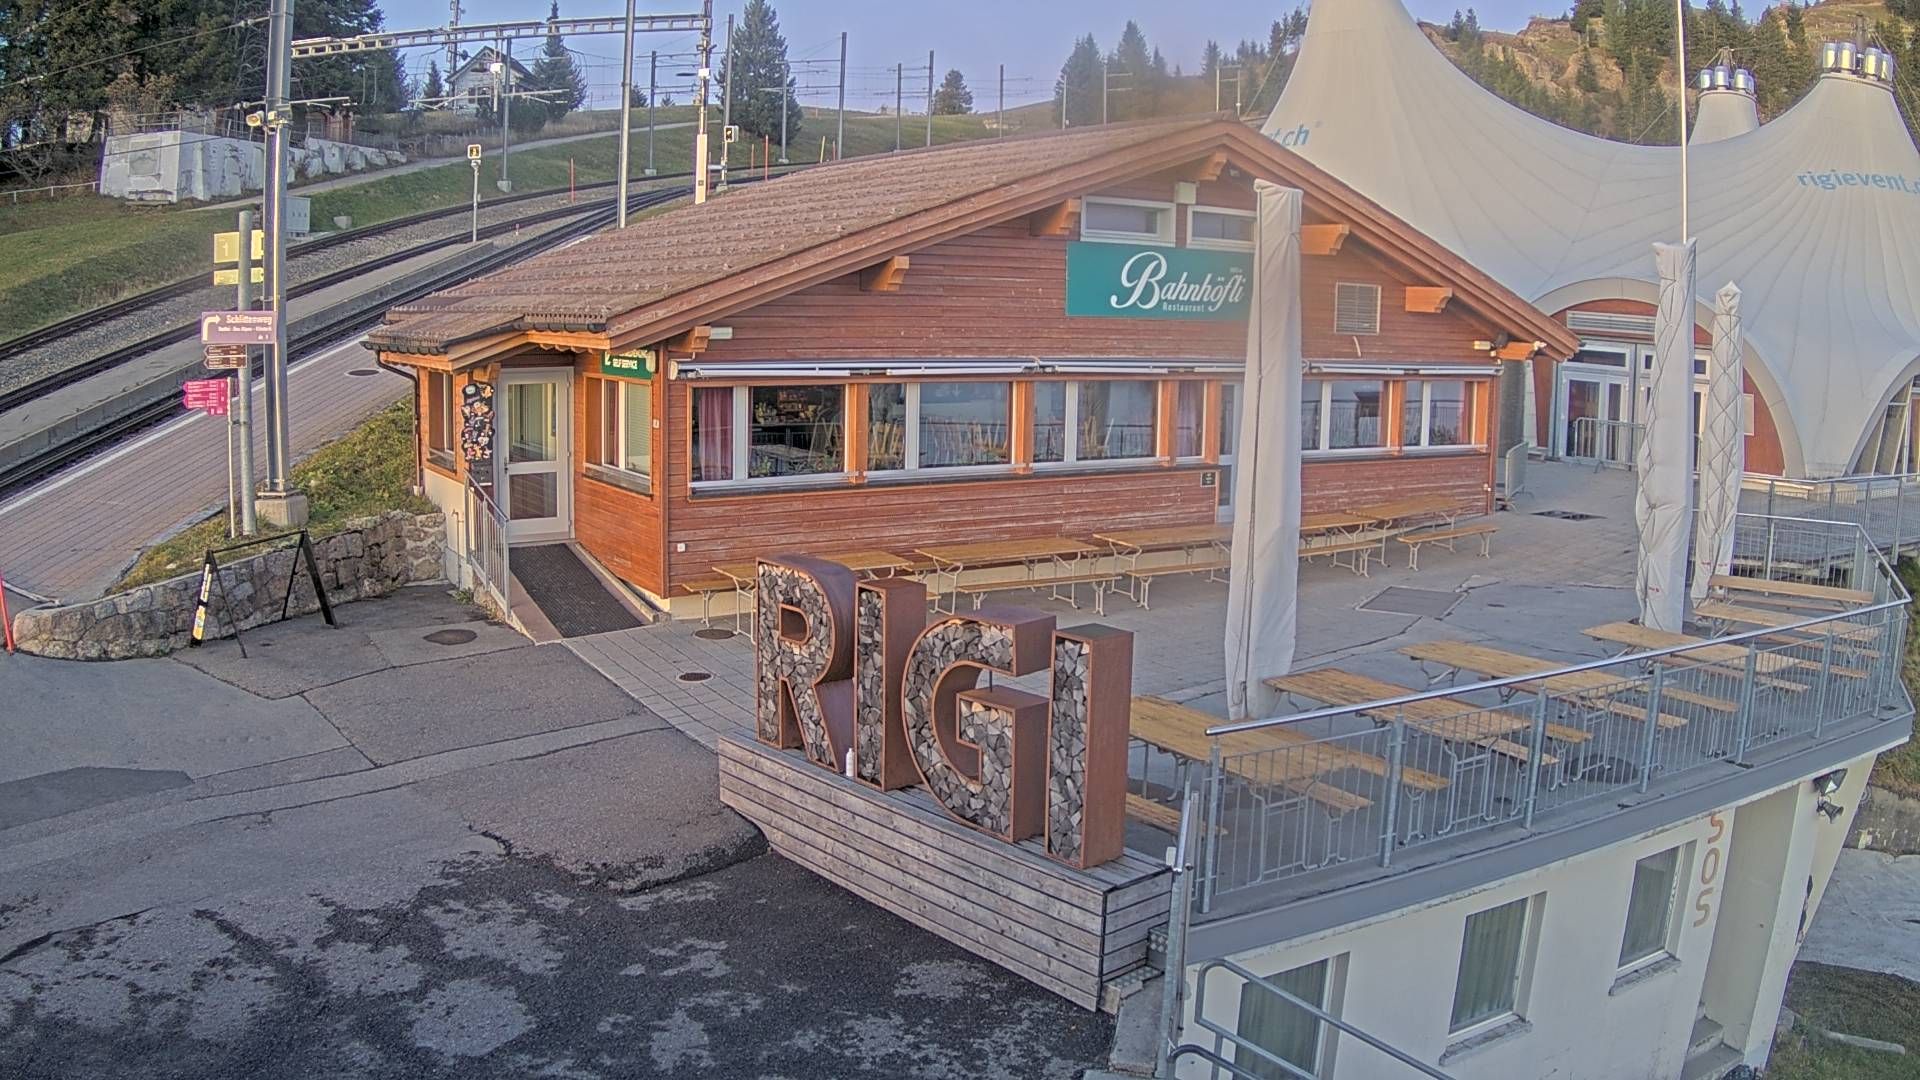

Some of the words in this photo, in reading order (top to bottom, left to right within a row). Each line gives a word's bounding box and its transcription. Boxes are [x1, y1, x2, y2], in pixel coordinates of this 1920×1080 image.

[1110, 251, 1247, 313] Bahnhöfli
[1162, 302, 1205, 313] Restaurant
[755, 555, 1134, 870] RIGI
[1693, 813, 1725, 928] SOS
